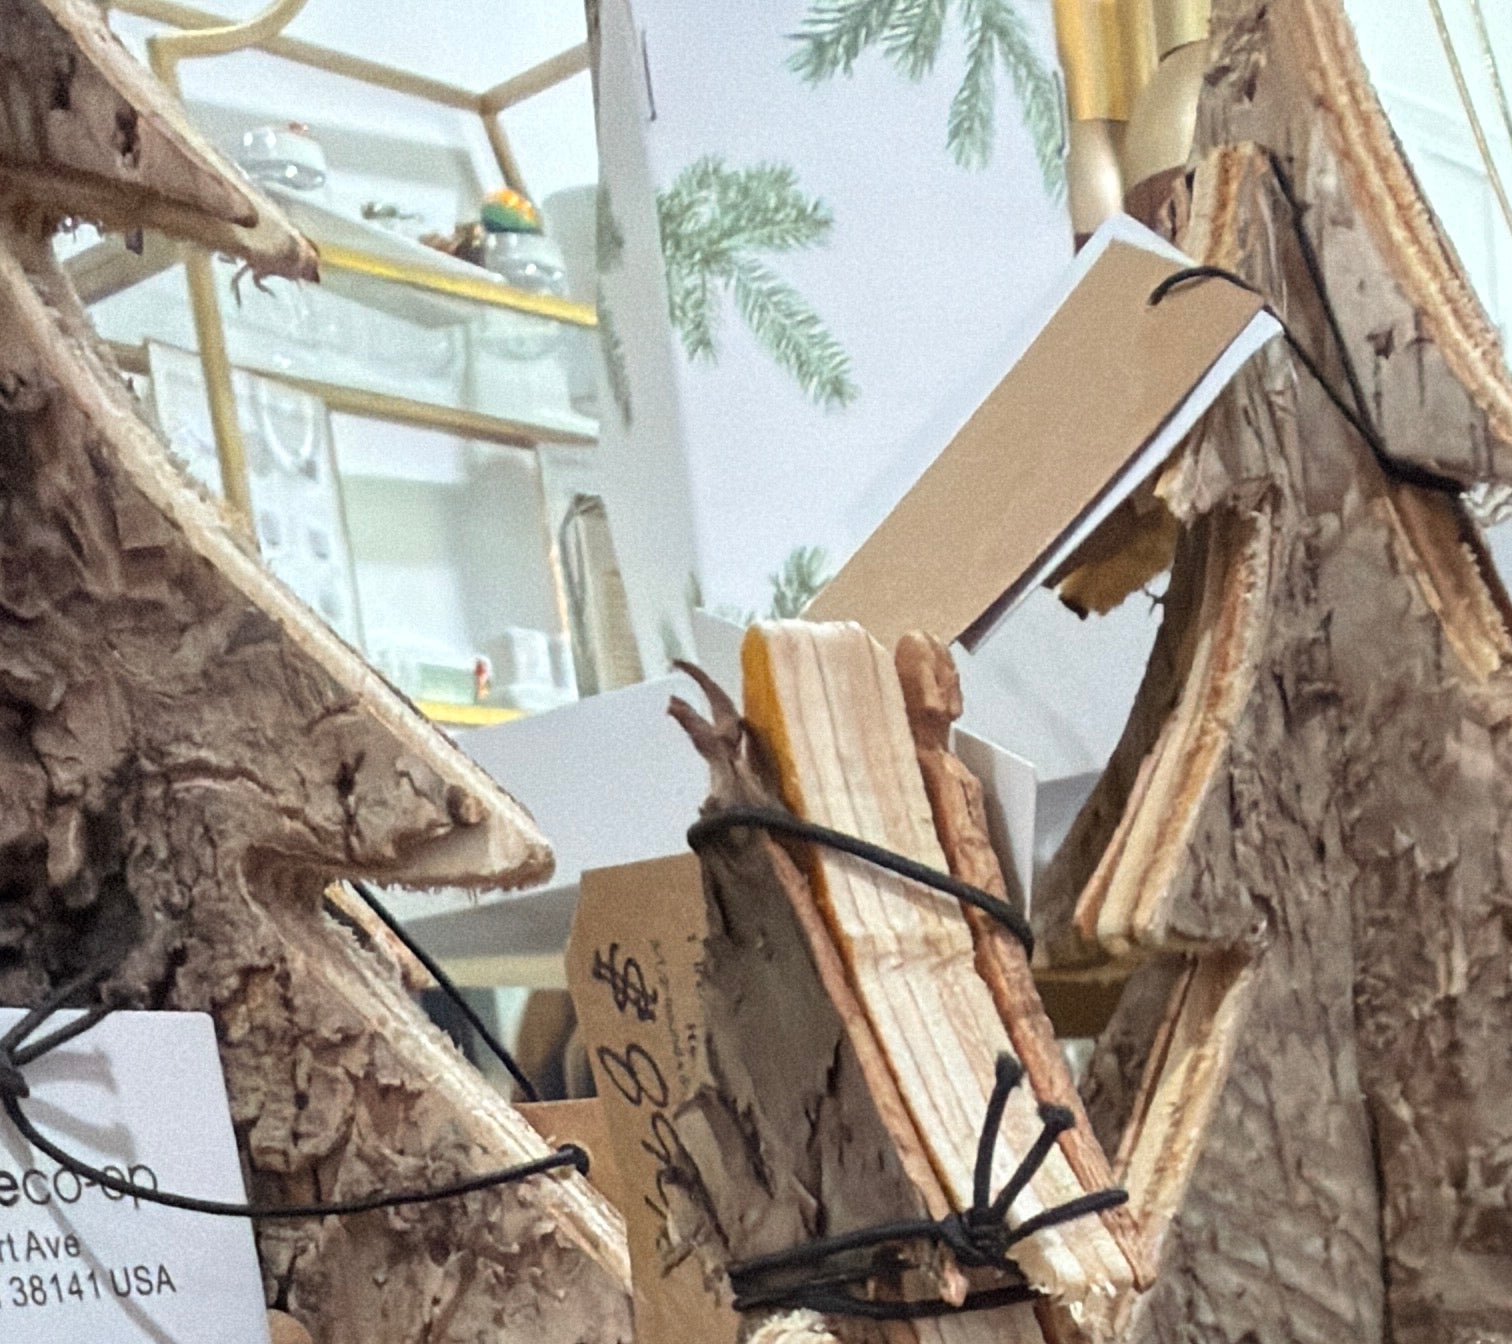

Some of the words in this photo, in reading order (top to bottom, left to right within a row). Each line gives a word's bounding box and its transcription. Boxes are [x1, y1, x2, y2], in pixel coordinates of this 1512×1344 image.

[26, 1230, 82, 1262] Ave
[9, 1270, 101, 1307] 38141
[110, 1263, 178, 1298] USA
